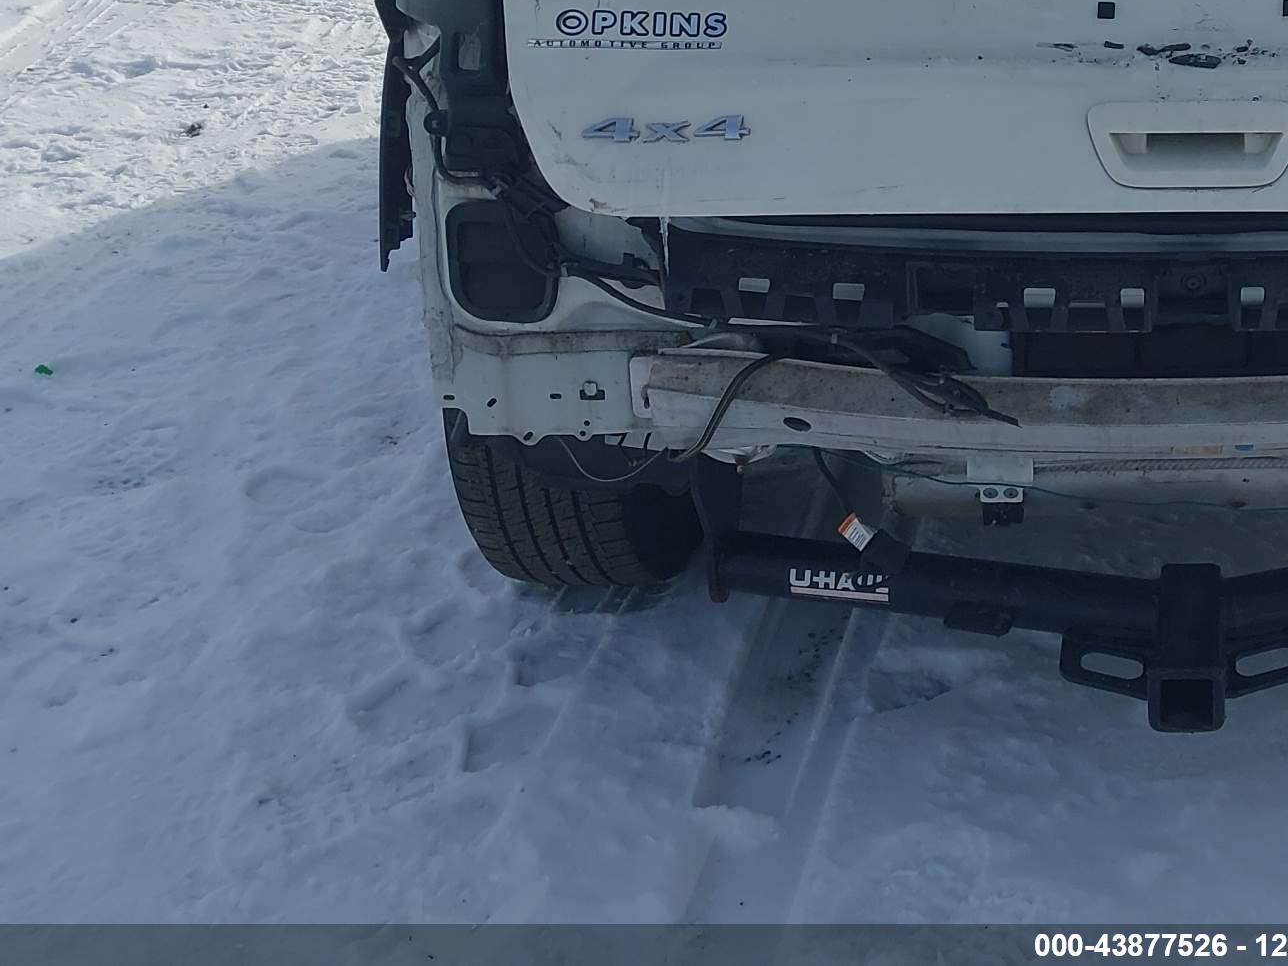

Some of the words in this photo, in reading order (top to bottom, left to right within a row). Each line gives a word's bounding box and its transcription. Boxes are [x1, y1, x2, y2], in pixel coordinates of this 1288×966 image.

[556, 9, 727, 38] OPKINS
[533, 39, 648, 49] AUTOMOTIVE
[660, 40, 716, 50] GROUP
[582, 114, 751, 143] 4x4
